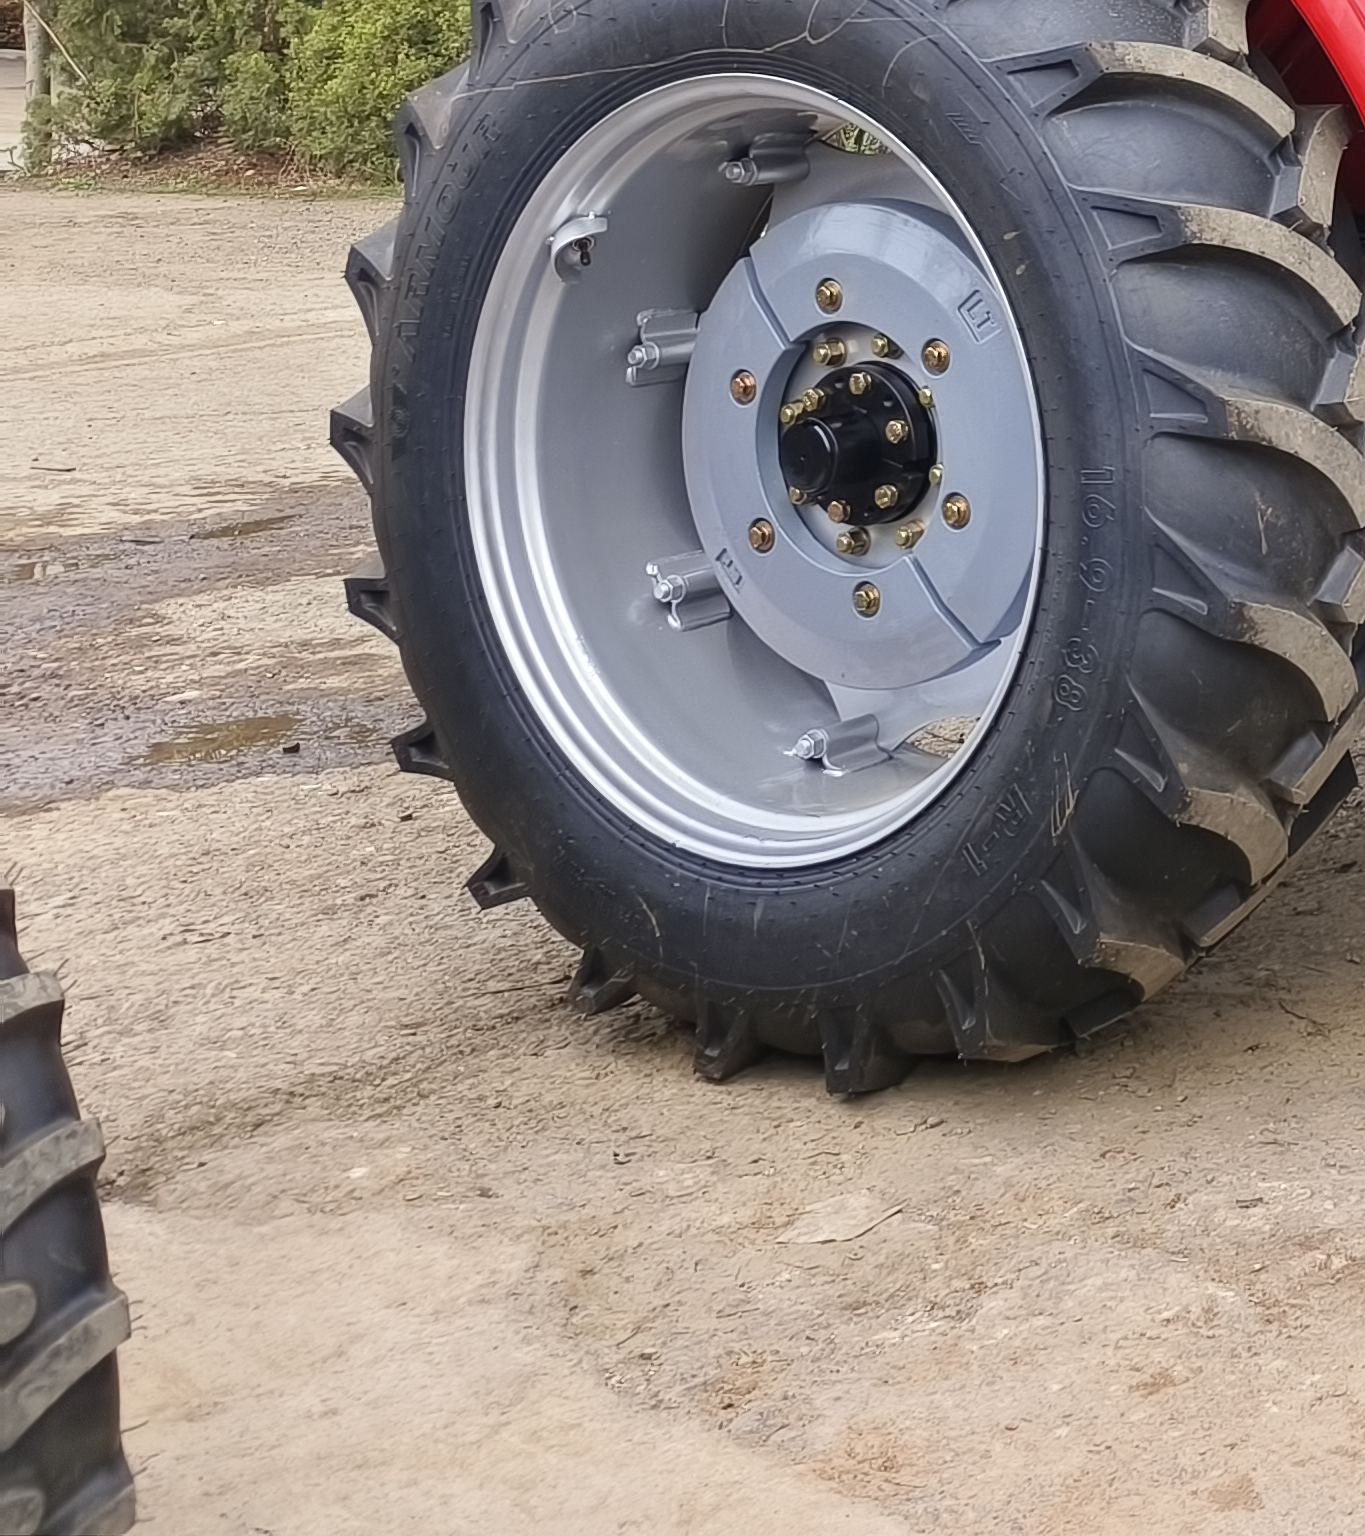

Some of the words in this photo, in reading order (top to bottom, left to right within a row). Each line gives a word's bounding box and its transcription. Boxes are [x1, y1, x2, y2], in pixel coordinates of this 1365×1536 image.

[396, 113, 501, 363] ARMOUR
[965, 297, 996, 330] LT
[1053, 463, 1116, 711] 16.9-38
[962, 783, 1031, 878] R-1
